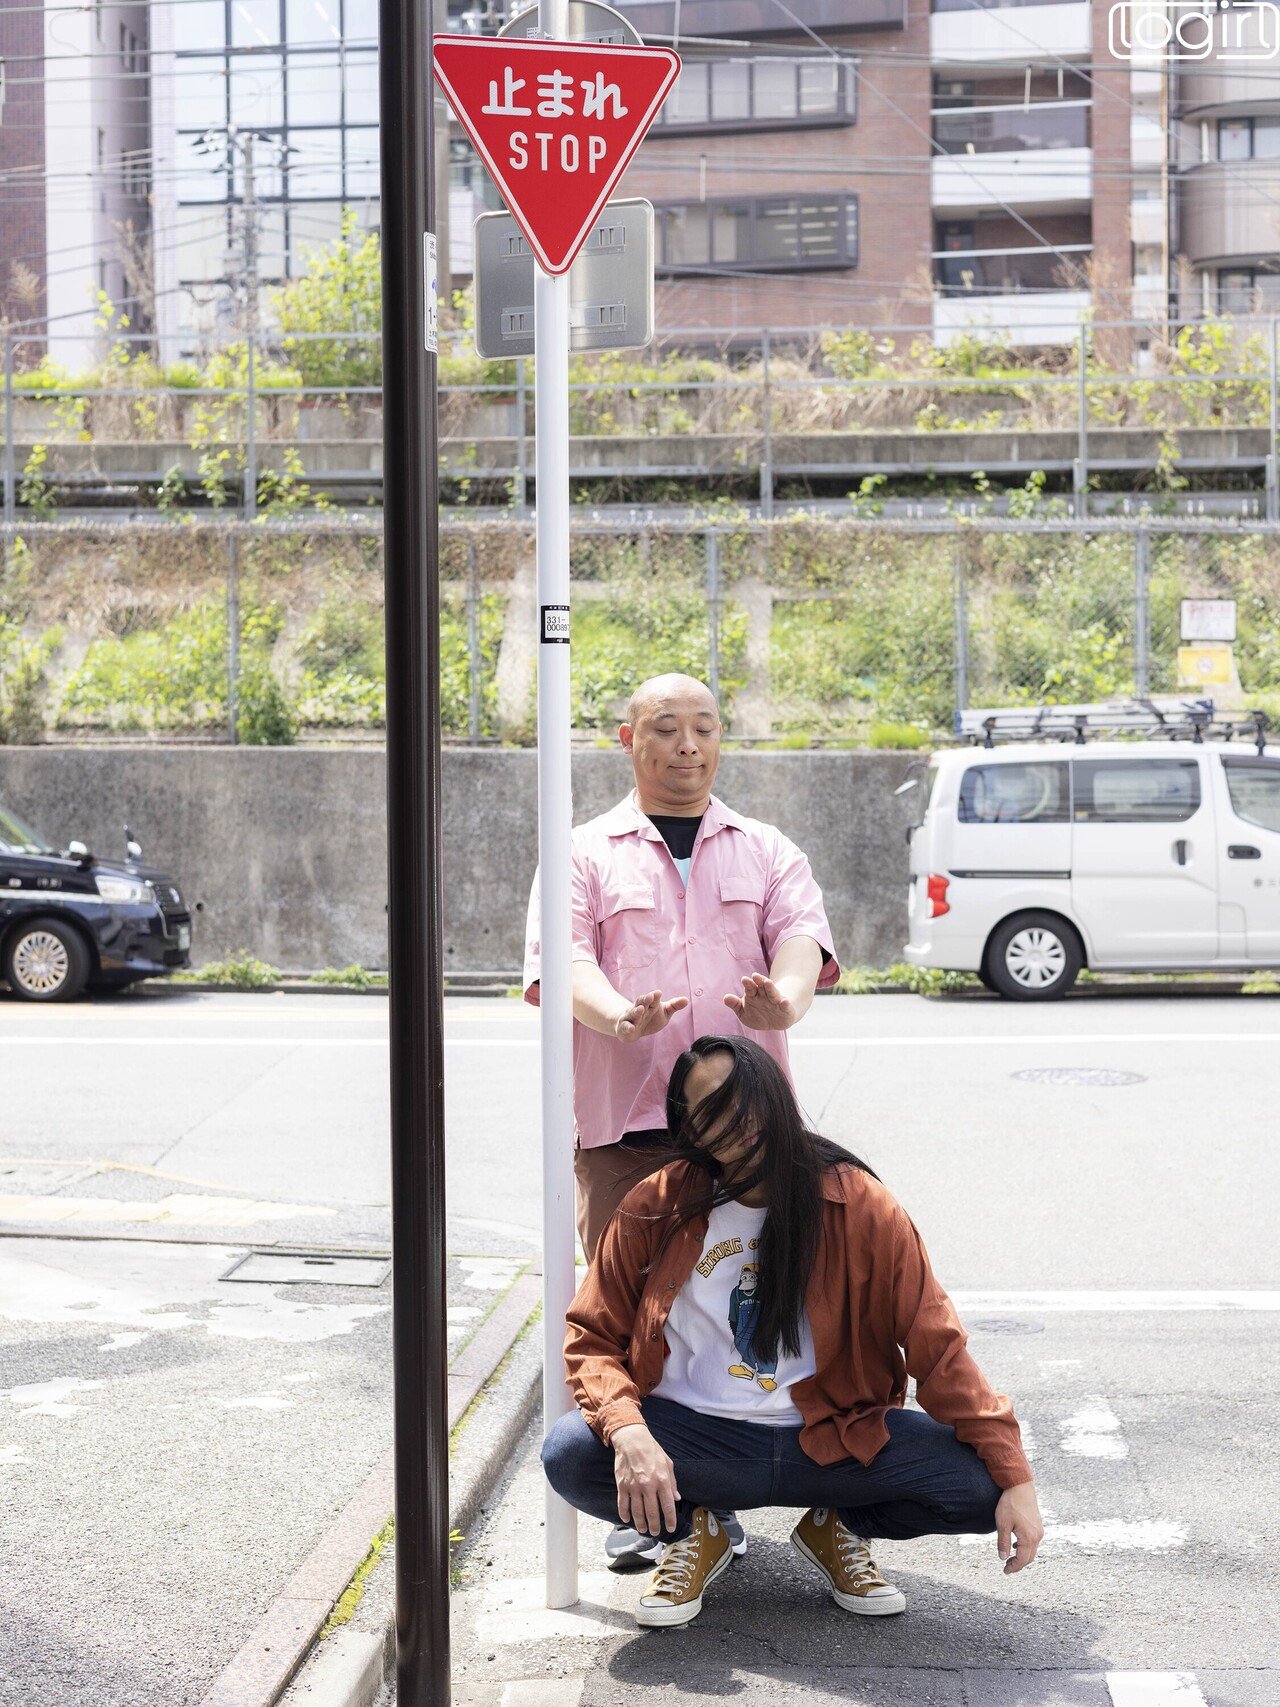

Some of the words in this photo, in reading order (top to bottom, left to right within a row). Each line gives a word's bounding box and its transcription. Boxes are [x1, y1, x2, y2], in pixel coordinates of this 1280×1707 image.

[481, 66, 629, 120] 止まれ
[509, 131, 607, 174] STOP
[696, 1237, 744, 1279] STRONG
